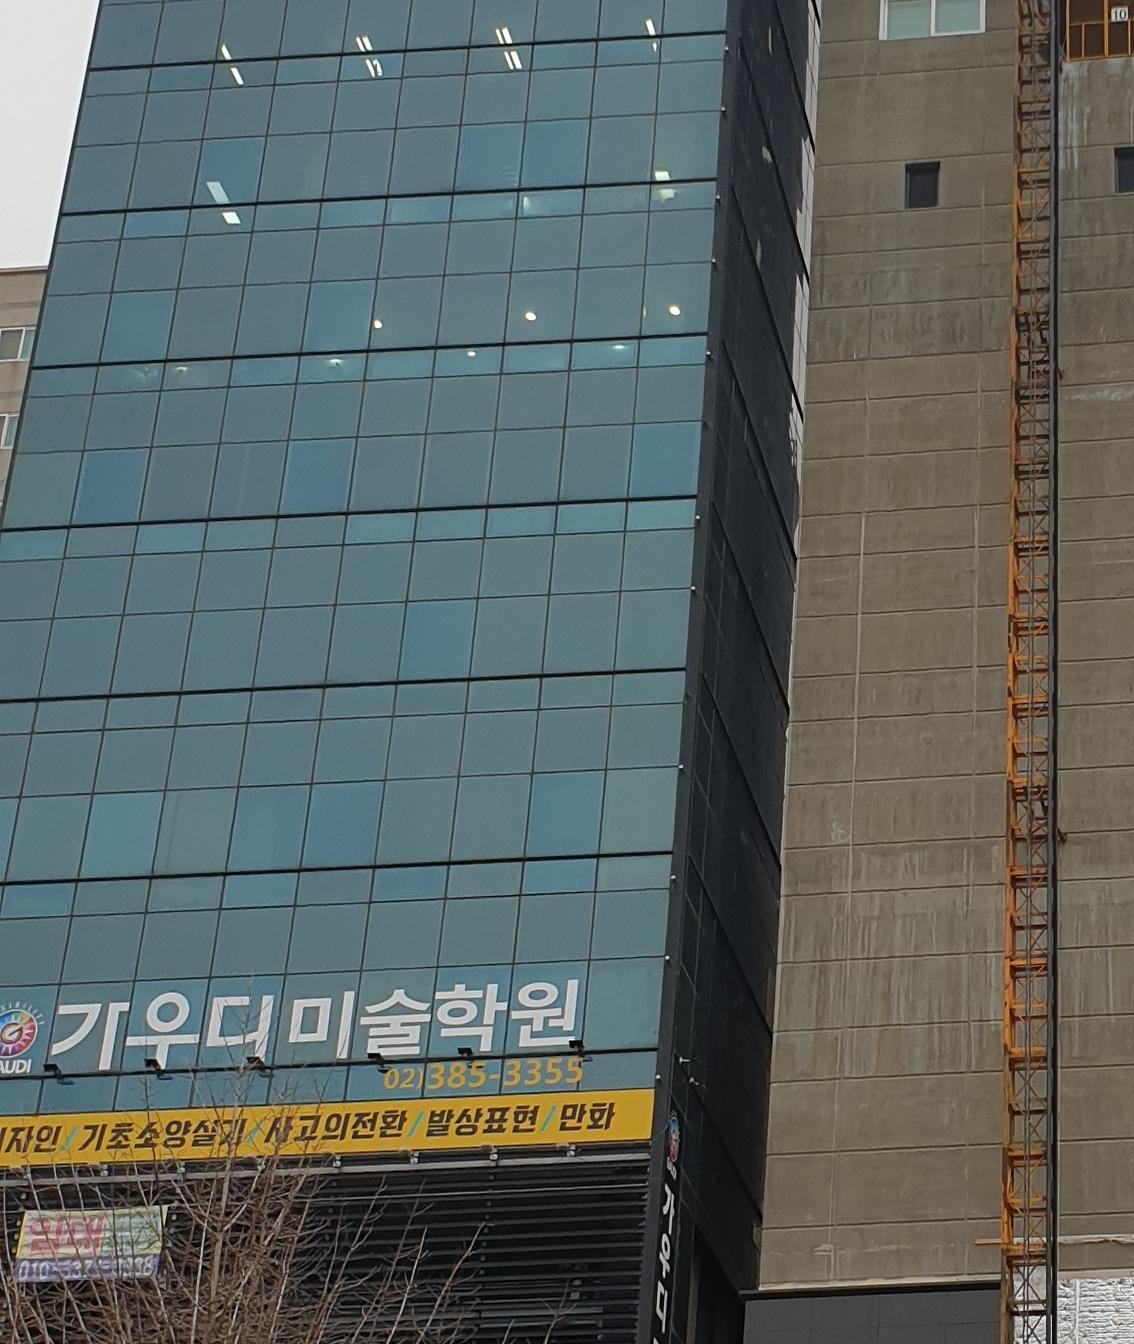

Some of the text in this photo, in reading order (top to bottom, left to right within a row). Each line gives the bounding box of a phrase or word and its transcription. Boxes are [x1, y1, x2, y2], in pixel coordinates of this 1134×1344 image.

[51, 978, 580, 1071] 가우디미술학원
[383, 1056, 585, 1091] 02)385-3355
[425, 1105, 541, 1138] 발상표현
[559, 1102, 616, 1133] 만화
